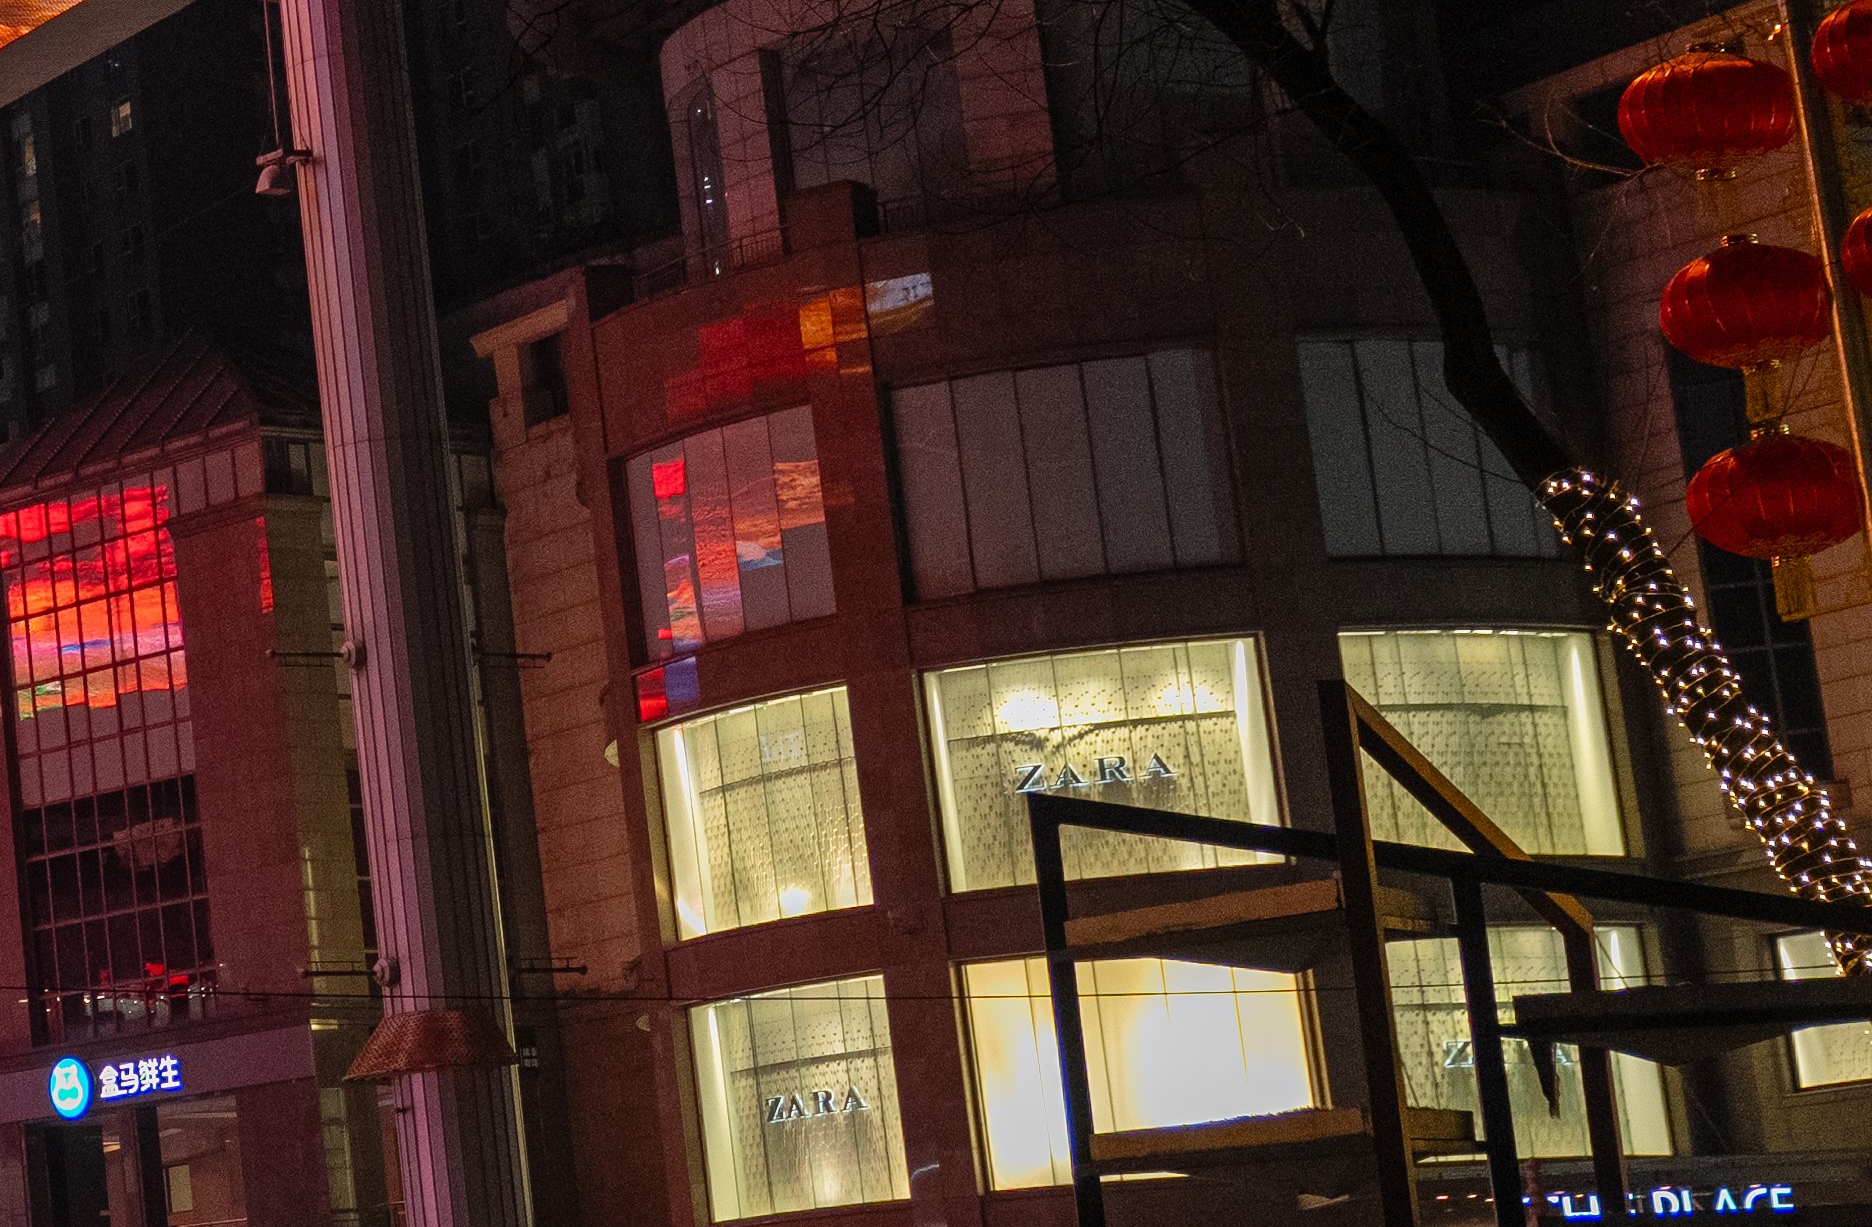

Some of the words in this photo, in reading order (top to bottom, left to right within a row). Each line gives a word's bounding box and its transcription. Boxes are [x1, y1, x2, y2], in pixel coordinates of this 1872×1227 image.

[1015, 752, 1179, 793] ZARA
[99, 1055, 181, 1099] 盒马鲜生
[765, 1085, 871, 1124] ZARA
